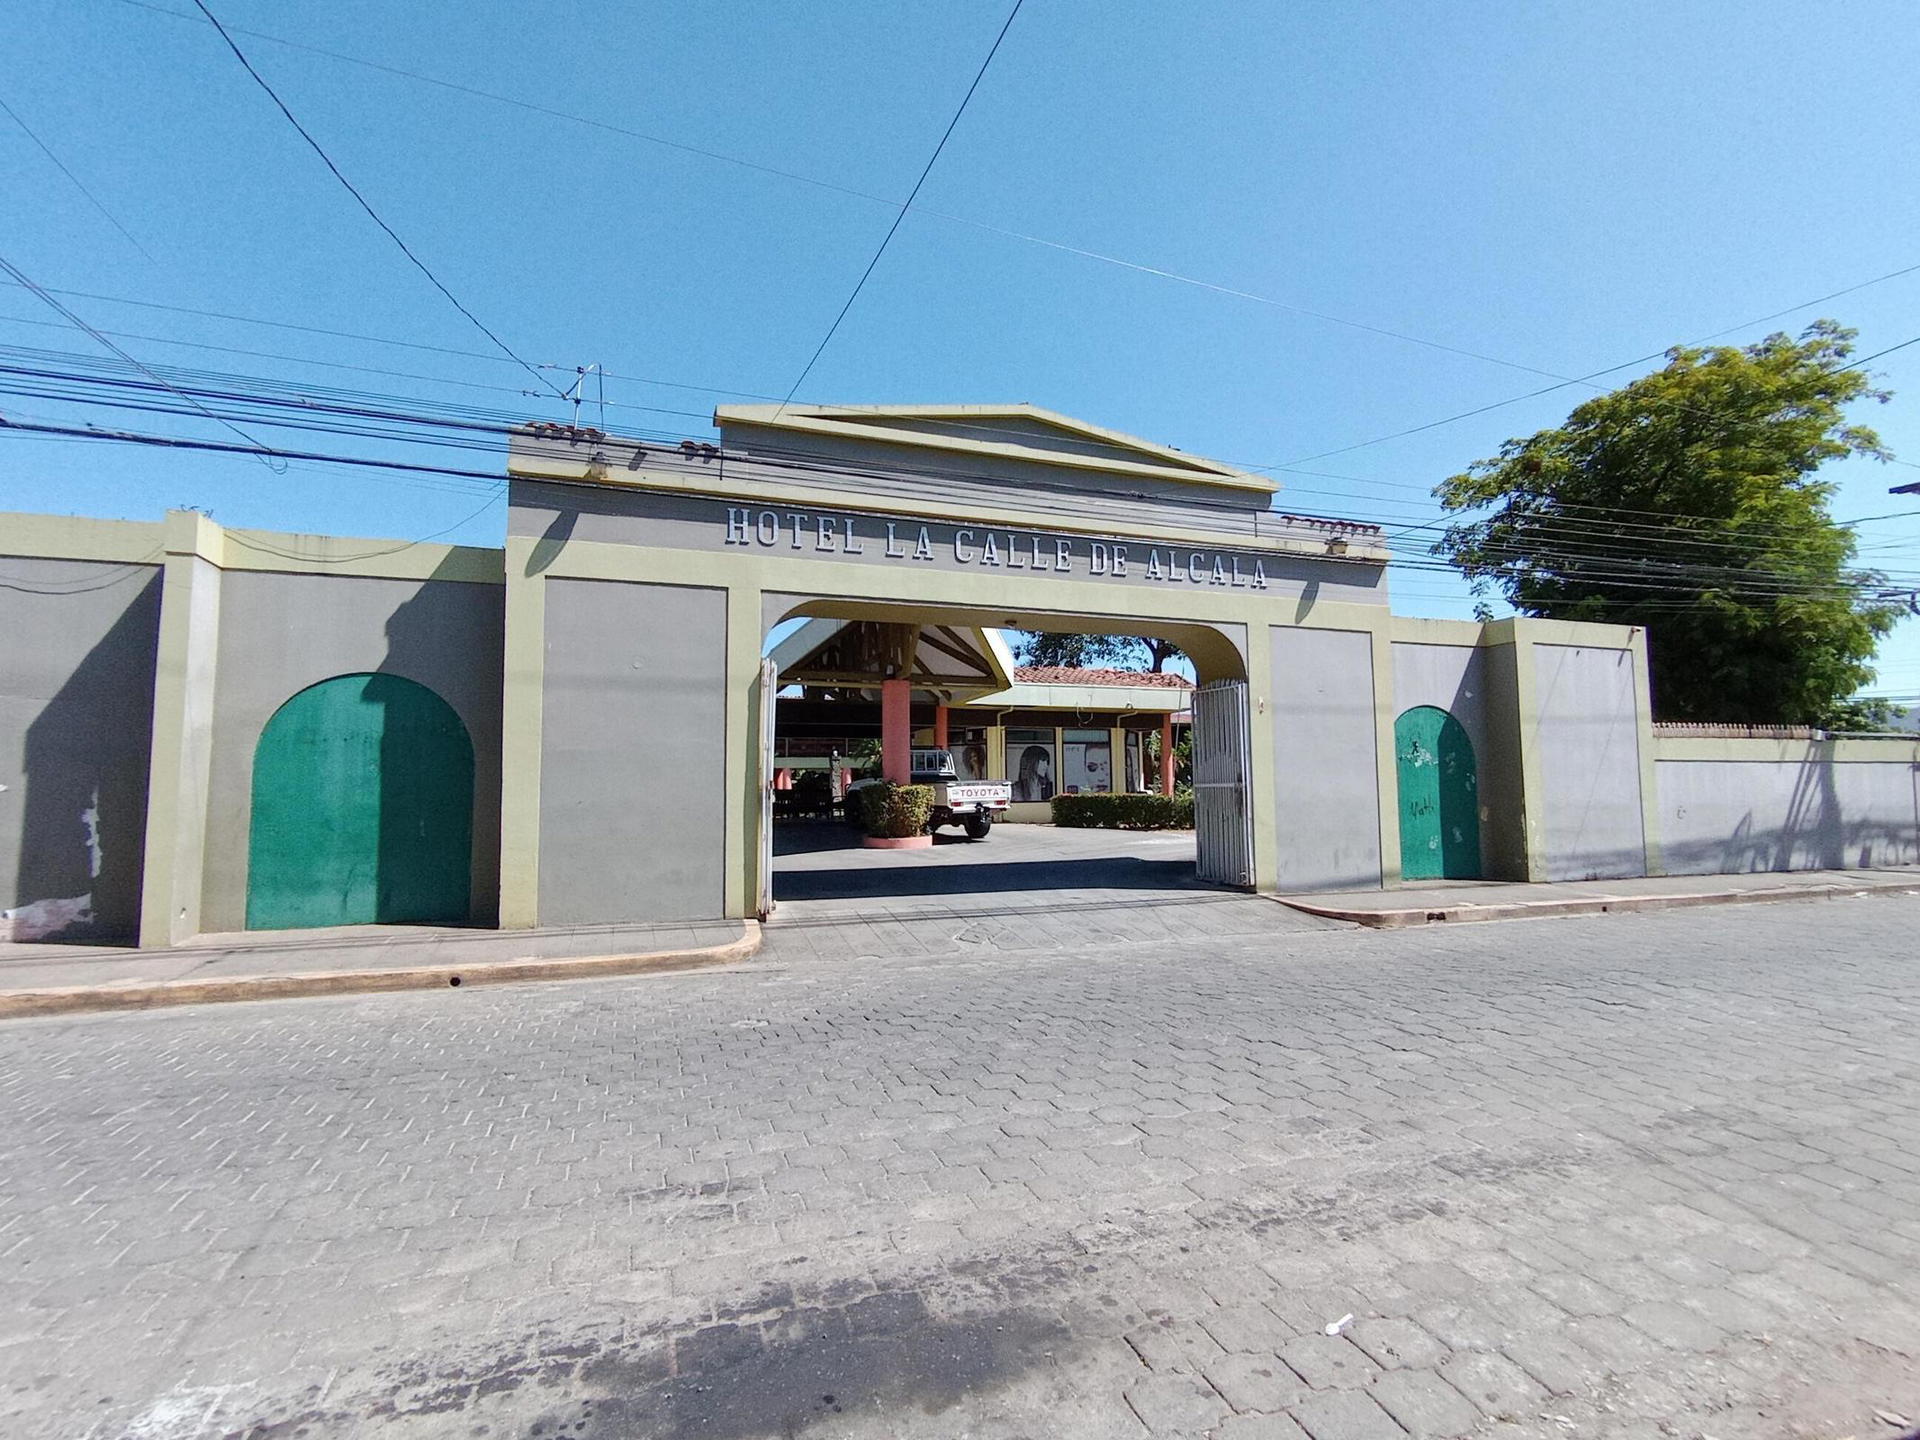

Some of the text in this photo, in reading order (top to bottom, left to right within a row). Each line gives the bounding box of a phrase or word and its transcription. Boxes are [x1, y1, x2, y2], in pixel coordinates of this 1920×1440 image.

[725, 507, 1268, 590] HOTEL LA CALLE DE ALCALA
[960, 788, 999, 797] TOYOTA
